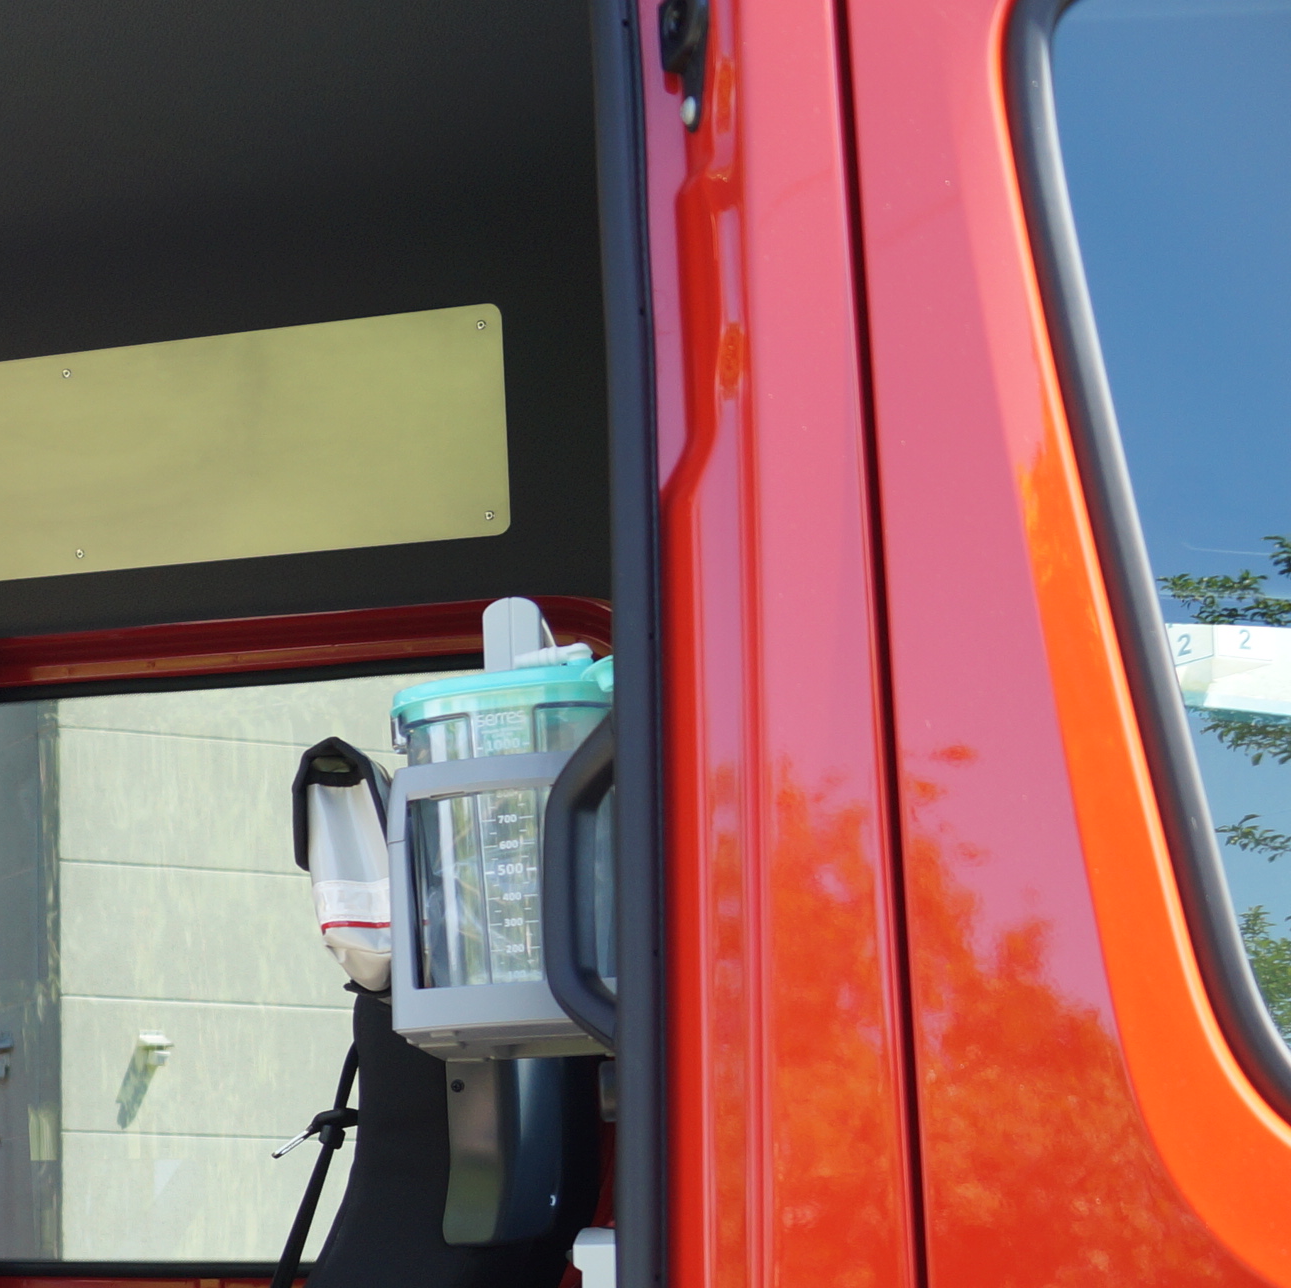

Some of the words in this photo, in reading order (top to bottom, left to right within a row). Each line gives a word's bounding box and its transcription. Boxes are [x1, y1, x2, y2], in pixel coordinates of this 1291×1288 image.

[1238, 629, 1251, 650] 2
[1177, 633, 1192, 657] 2
[497, 814, 517, 824] 700
[499, 839, 519, 849] 600
[497, 863, 523, 876] 500
[502, 891, 522, 901] 400
[504, 917, 523, 927] 300
[506, 943, 525, 953] 200
